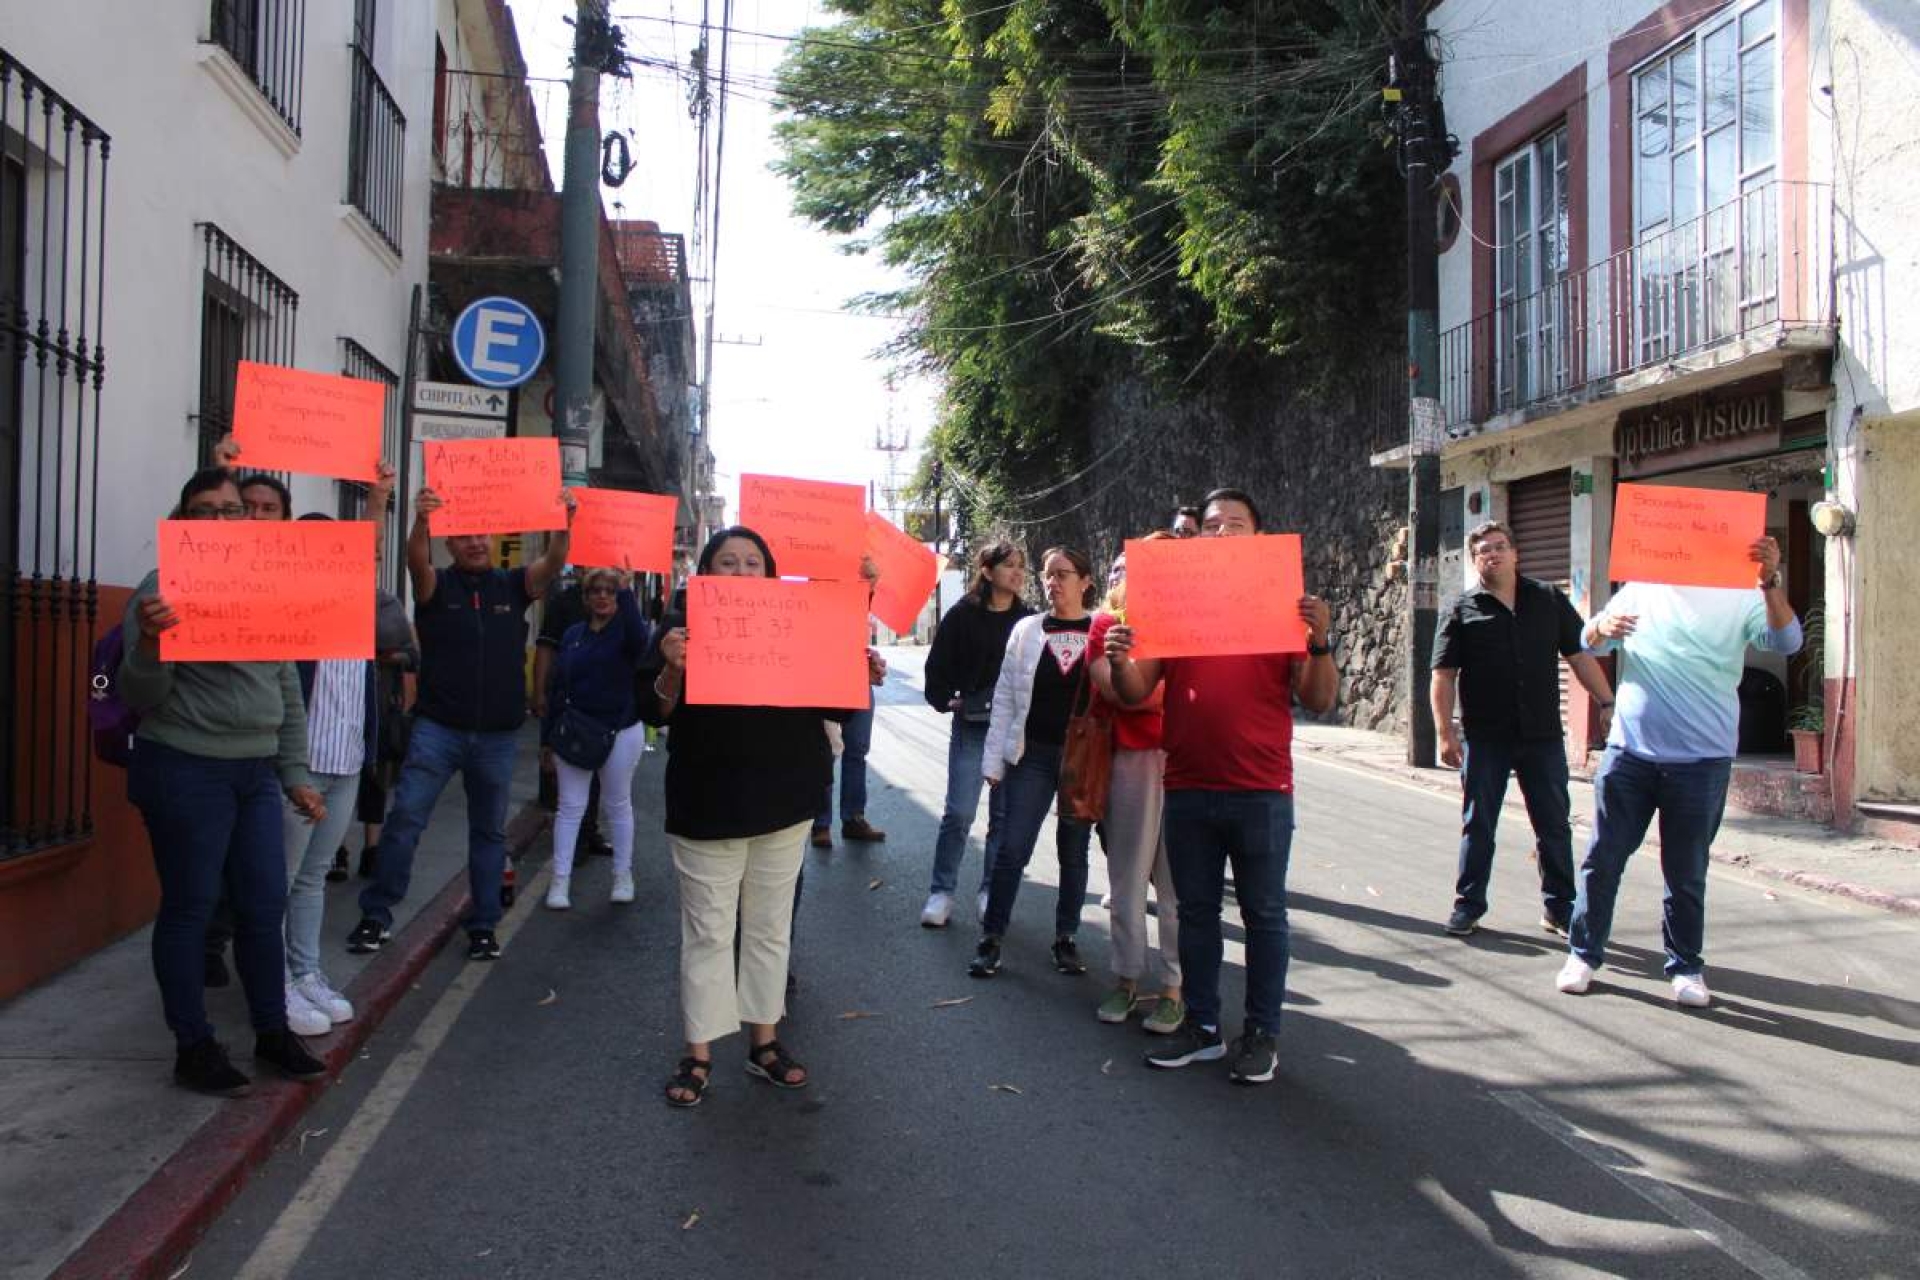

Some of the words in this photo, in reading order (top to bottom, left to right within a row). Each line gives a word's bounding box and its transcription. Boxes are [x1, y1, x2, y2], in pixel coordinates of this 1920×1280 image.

[472, 307, 526, 376] E
[179, 530, 244, 563] Apoyo
[252, 532, 307, 558] total
[332, 541, 346, 555] a
